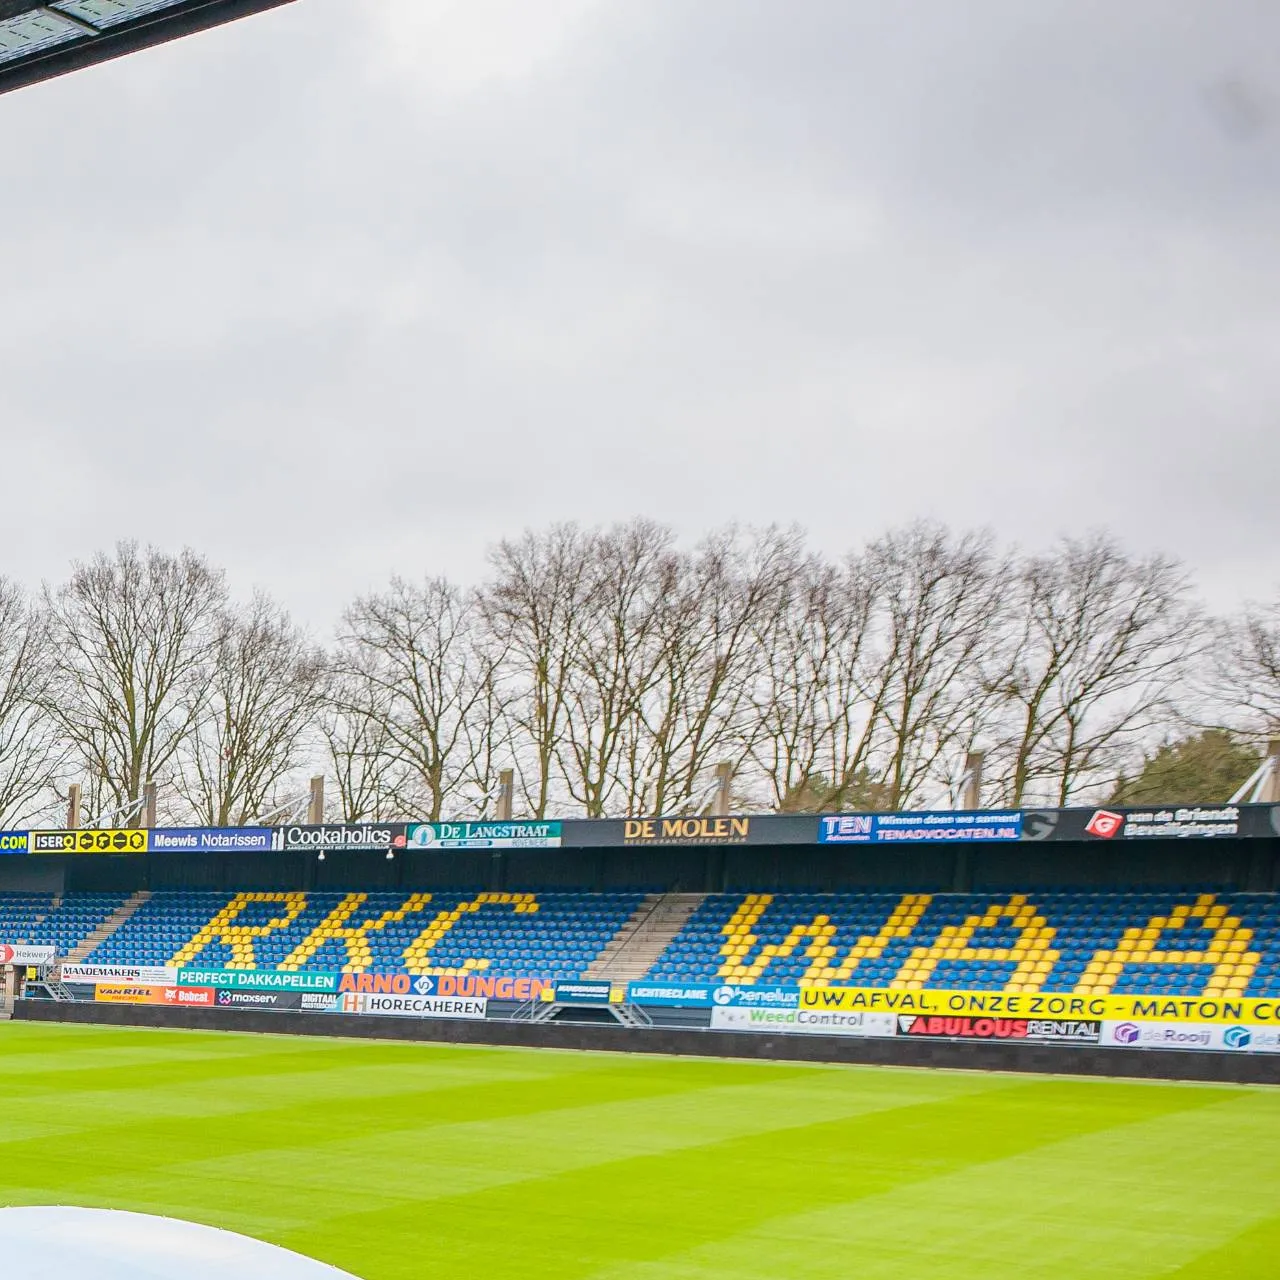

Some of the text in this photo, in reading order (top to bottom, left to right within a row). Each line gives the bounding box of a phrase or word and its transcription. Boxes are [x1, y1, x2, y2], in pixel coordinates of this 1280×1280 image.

[440, 823, 550, 839] DE LANGSTRAAT
[624, 818, 750, 839] DE MOLEN
[822, 815, 873, 834] TEN
[154, 832, 266, 848] Meewis Notarissen
[287, 826, 392, 844] Cookaholics
[63, 966, 141, 978] MANDEMAKERS
[180, 971, 236, 985] PERFECT
[237, 973, 335, 988] DAKKAPELLEN
[338, 973, 410, 994] ARNO
[439, 975, 554, 1001] DUNGEN
[631, 987, 708, 1001] LICHTRECLAME
[369, 999, 485, 1015] HORECAHEREN
[804, 990, 1280, 1020] UW AFVAL, ONZE ZORG MATON C
[750, 1009, 864, 1026] WeedControl
